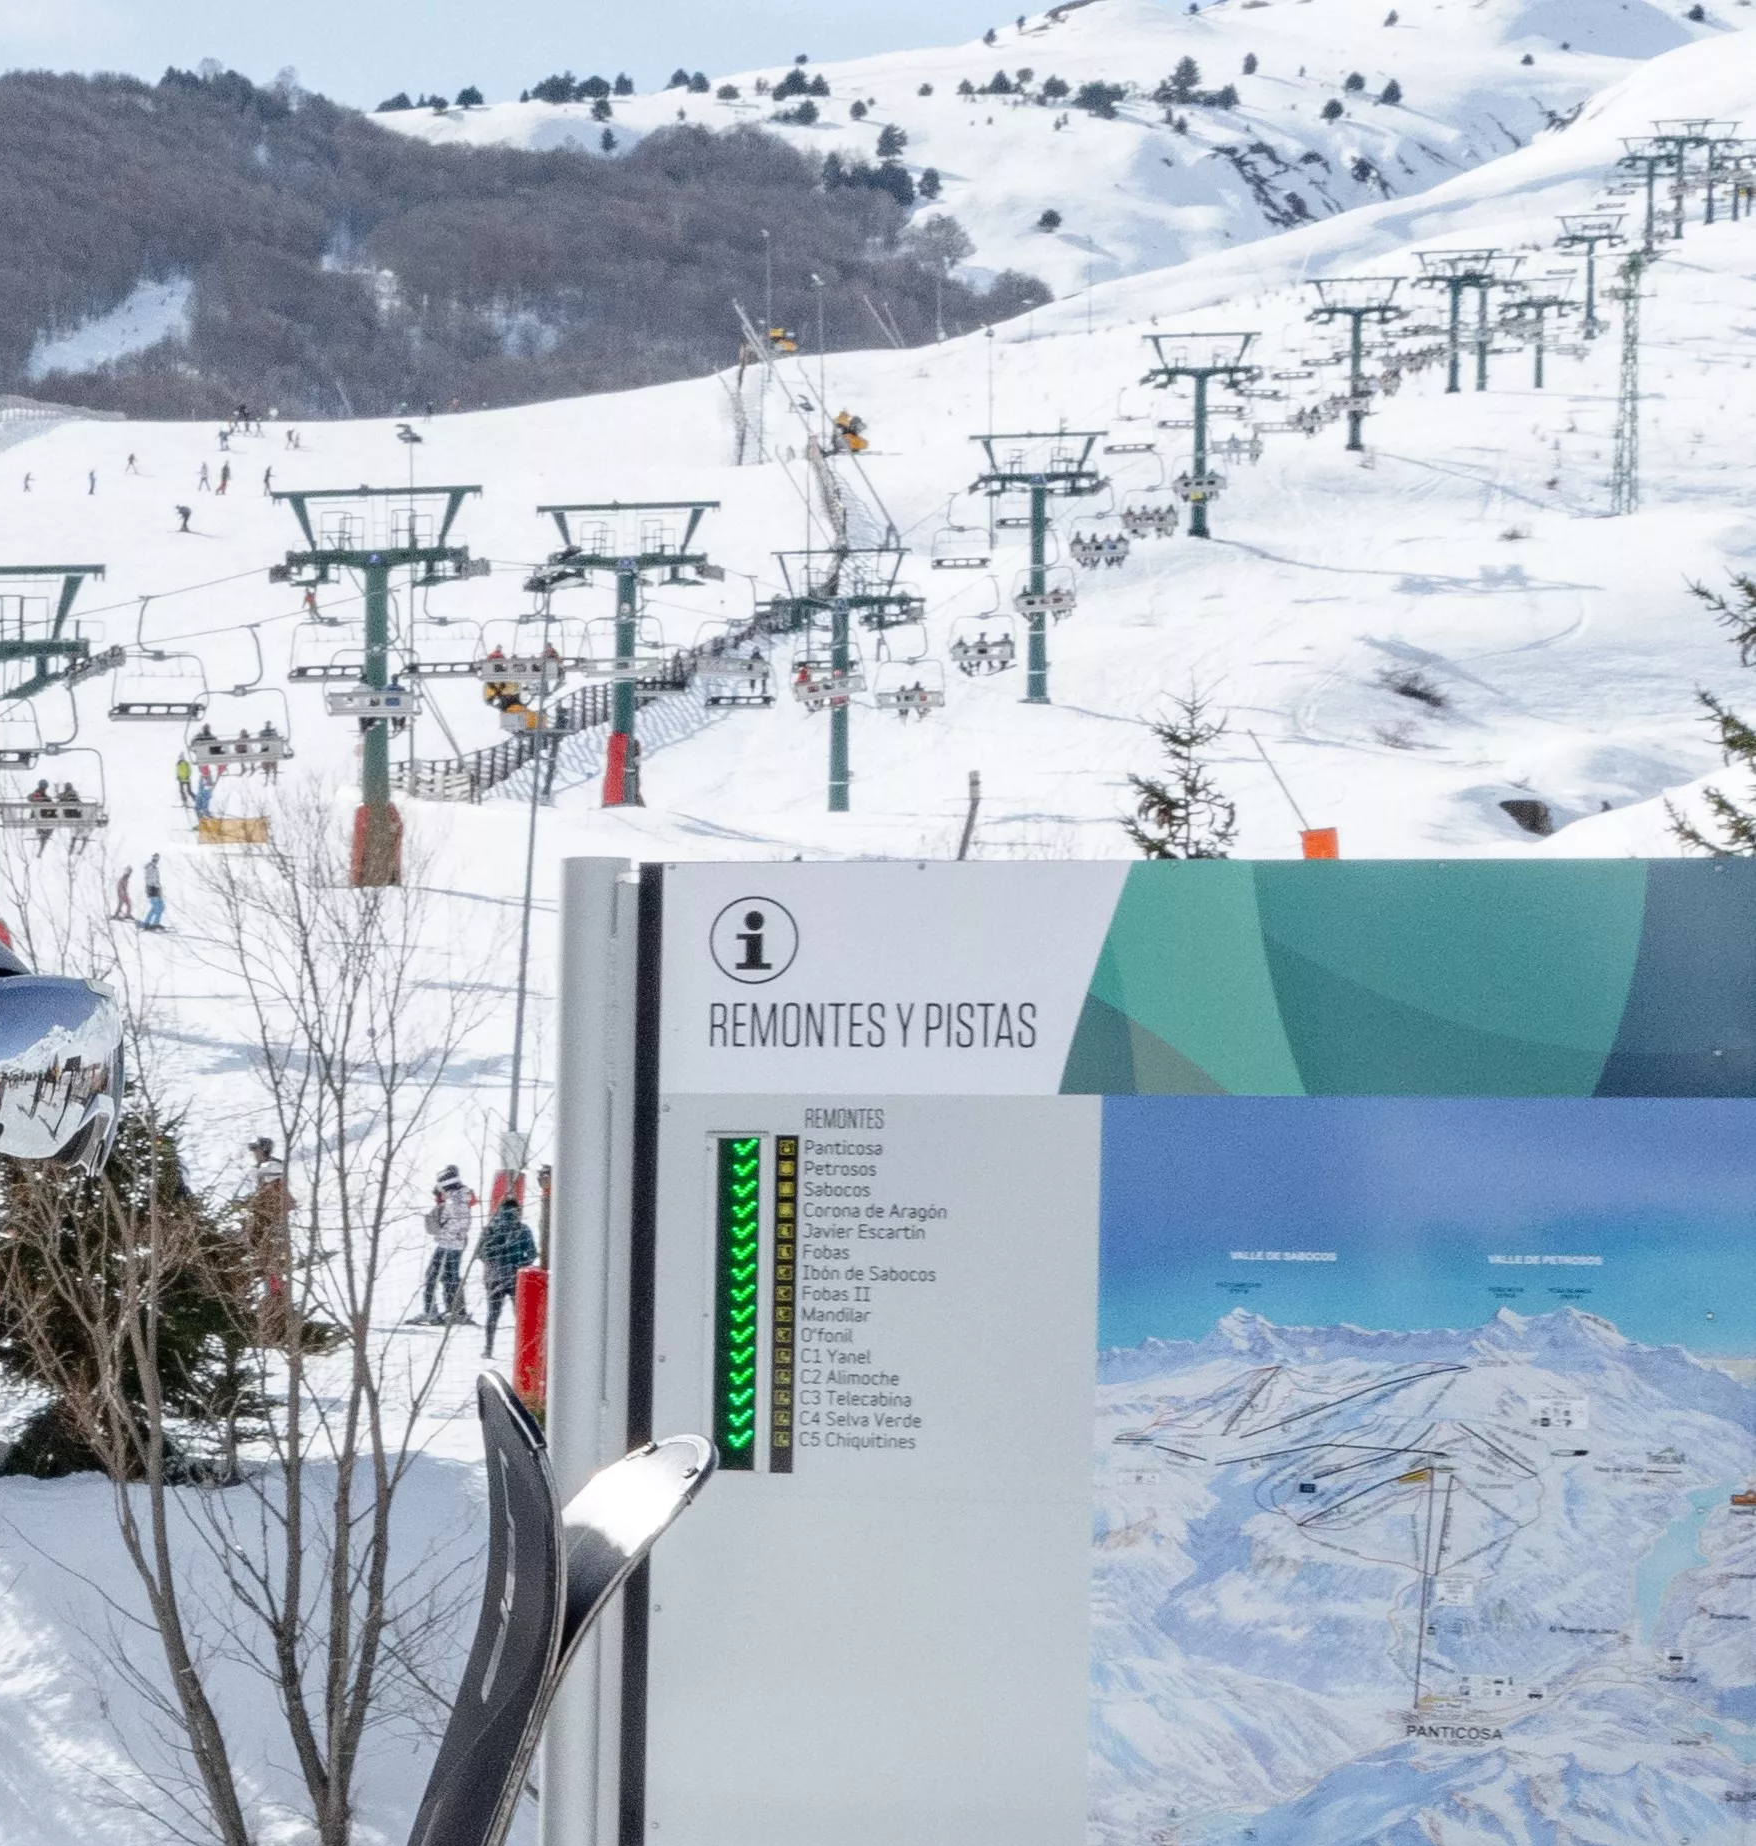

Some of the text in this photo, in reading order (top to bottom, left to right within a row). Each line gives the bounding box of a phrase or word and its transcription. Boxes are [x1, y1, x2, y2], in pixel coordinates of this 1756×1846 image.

[709, 1002, 1037, 1048] REMONTES Y PISTAS
[804, 1108, 884, 1129] REMONTES
[804, 1139, 883, 1155] Panticosa
[804, 1160, 877, 1177] Petrosos
[804, 1181, 871, 1197] Sabocos
[803, 1202, 947, 1221] Corona de Aragón
[803, 1223, 853, 1239] Javier
[802, 1244, 850, 1260] Fobas
[802, 1265, 936, 1282] Ibón de Sabocos
[801, 1285, 871, 1301] Fobas II
[801, 1306, 871, 1322] Mandilar
[800, 1348, 872, 1364] C1 Yanel
[800, 1369, 900, 1386] C2 Alimoche
[799, 1390, 912, 1407] C3 Telecabina
[799, 1411, 922, 1428] C4 Selva Verde
[799, 1432, 916, 1450] C5 Chiquitines
[1406, 1725, 1503, 1740] PANTICOSA
